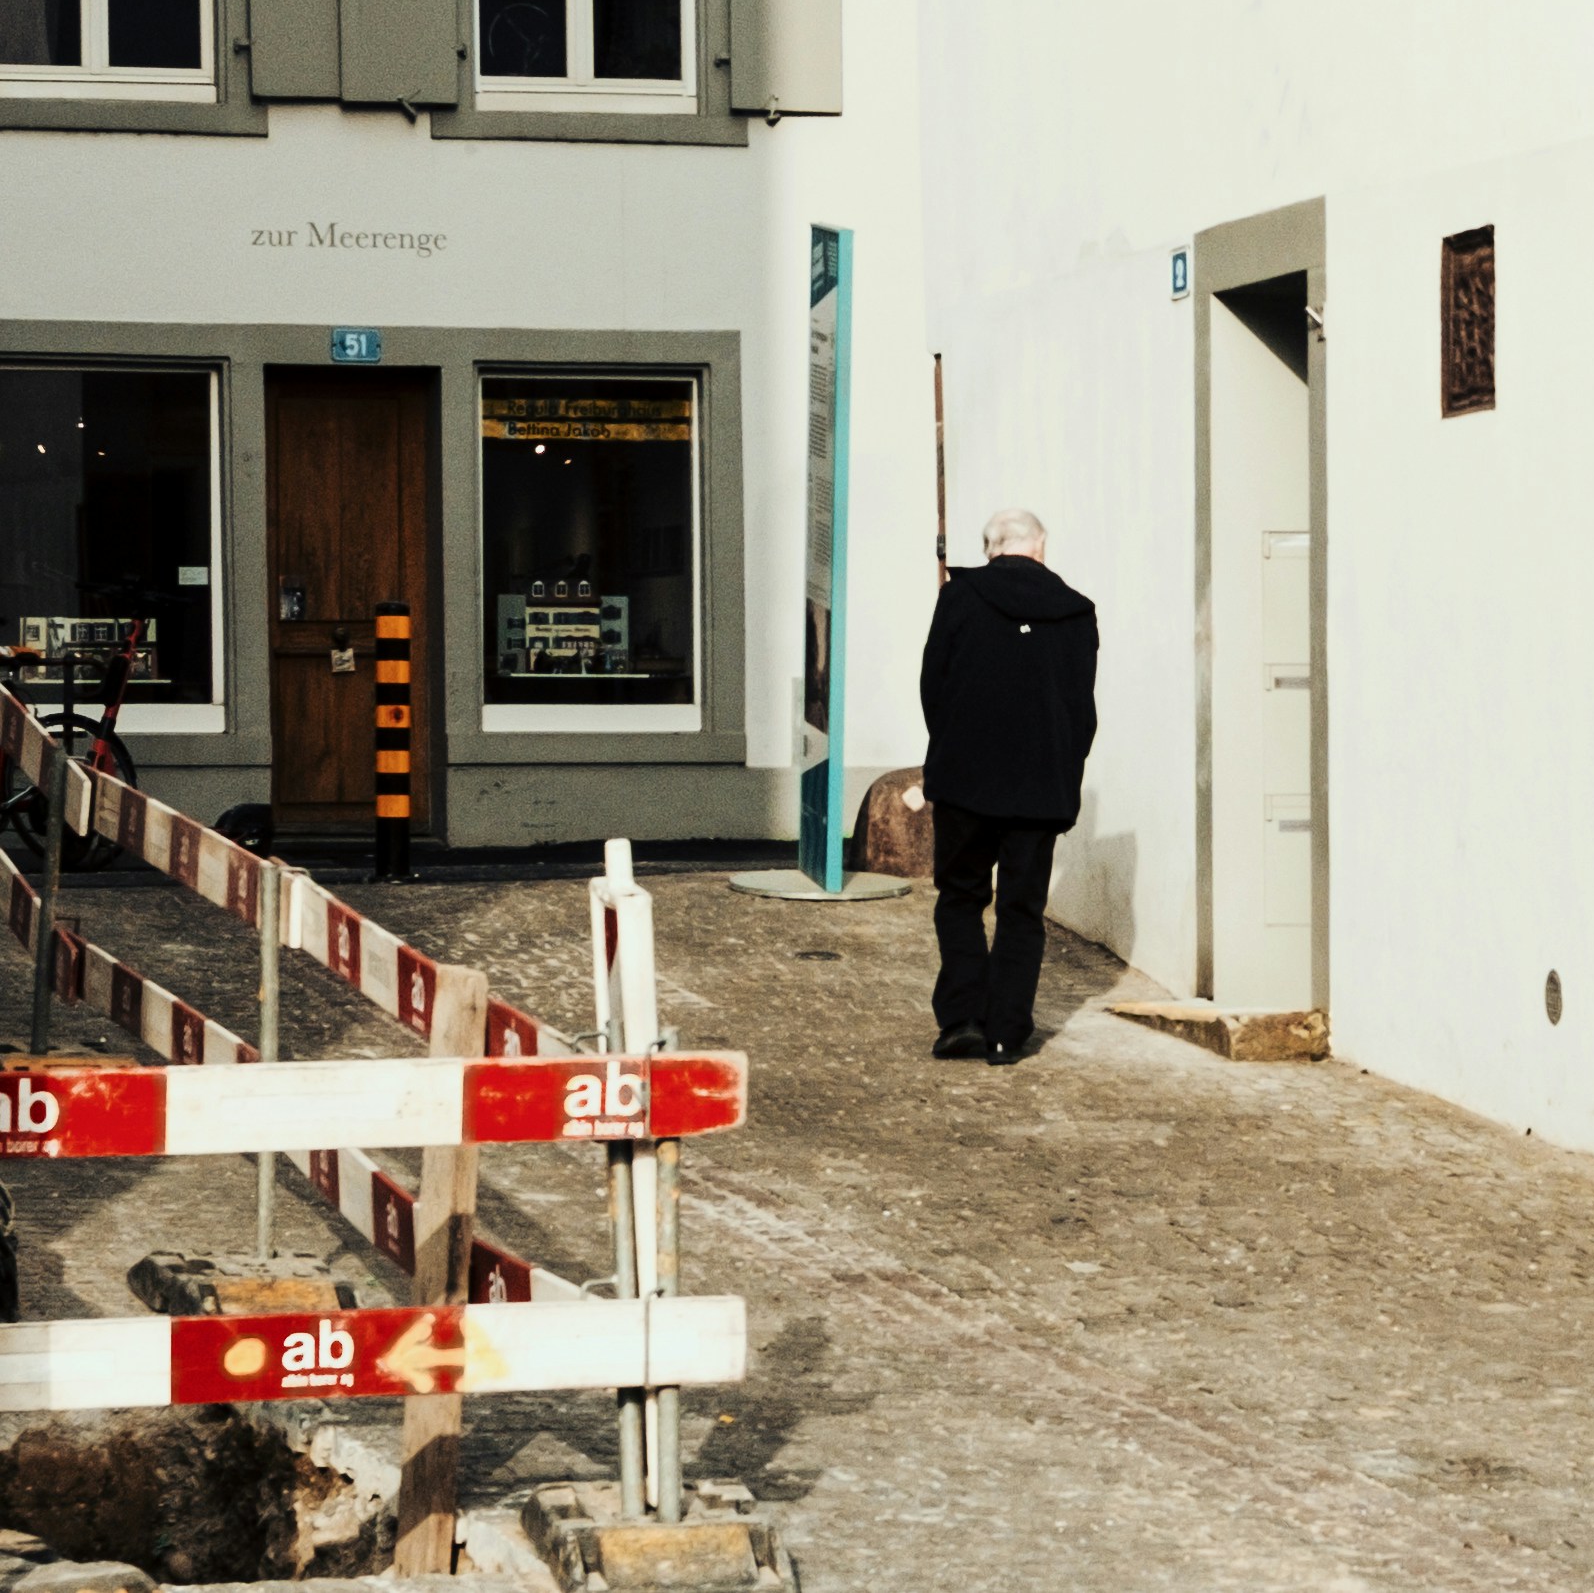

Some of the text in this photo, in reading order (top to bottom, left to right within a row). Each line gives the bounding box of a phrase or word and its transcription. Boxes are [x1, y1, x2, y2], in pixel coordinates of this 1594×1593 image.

[251, 221, 448, 258] zur Meerenge
[345, 333, 367, 357] 51
[507, 420, 612, 439] Bettina Jakob
[563, 1061, 644, 1118] ab
[281, 1318, 355, 1372] ab
